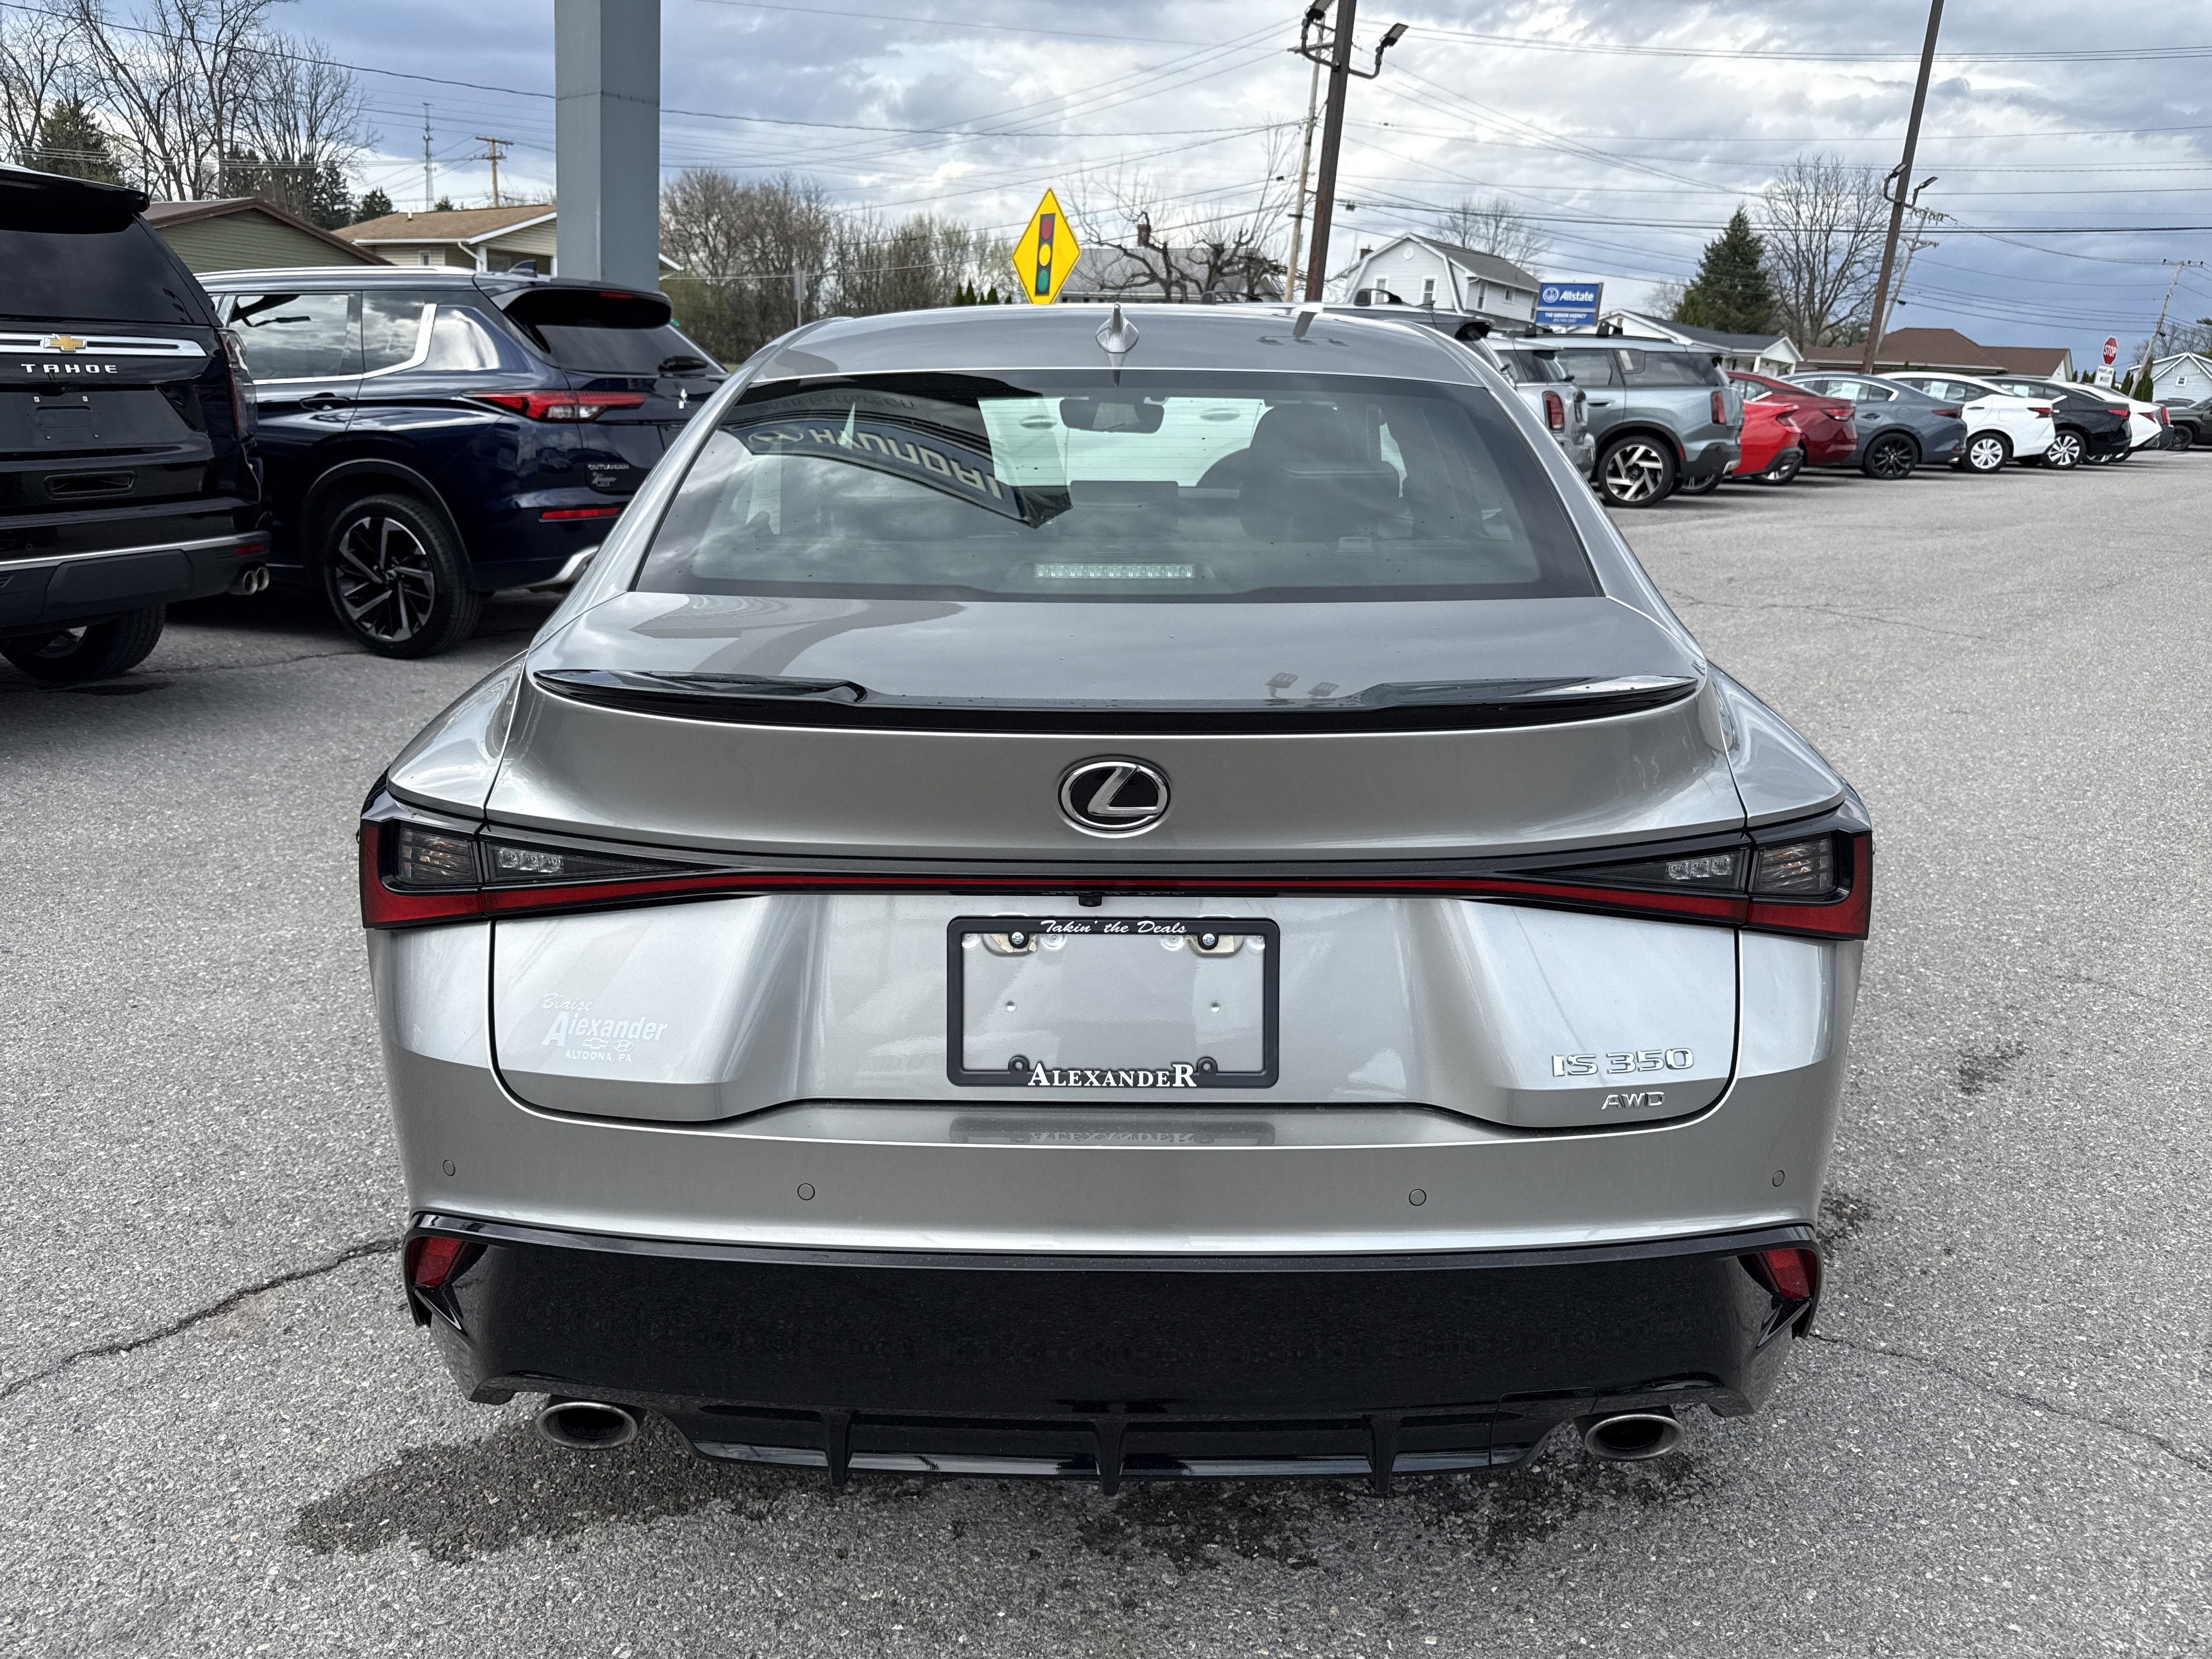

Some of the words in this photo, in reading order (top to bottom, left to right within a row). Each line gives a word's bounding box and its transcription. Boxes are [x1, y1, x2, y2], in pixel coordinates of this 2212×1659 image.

[1559, 290, 1594, 302] Allstate
[2103, 344, 2117, 357] STOP
[21, 364, 117, 374] TAHOE
[1103, 921, 1129, 933] the
[1137, 920, 1187, 933] Deals
[542, 992, 593, 1011] Blaise
[541, 1011, 669, 1047] Alexander
[565, 1049, 616, 1063] ALTOONA,
[619, 1053, 632, 1063] PA
[1551, 1053, 1598, 1076] IS
[1606, 1047, 1694, 1074] 350
[1028, 1063, 1197, 1087] ALEXANDER
[1600, 1091, 1665, 1110] AWD
